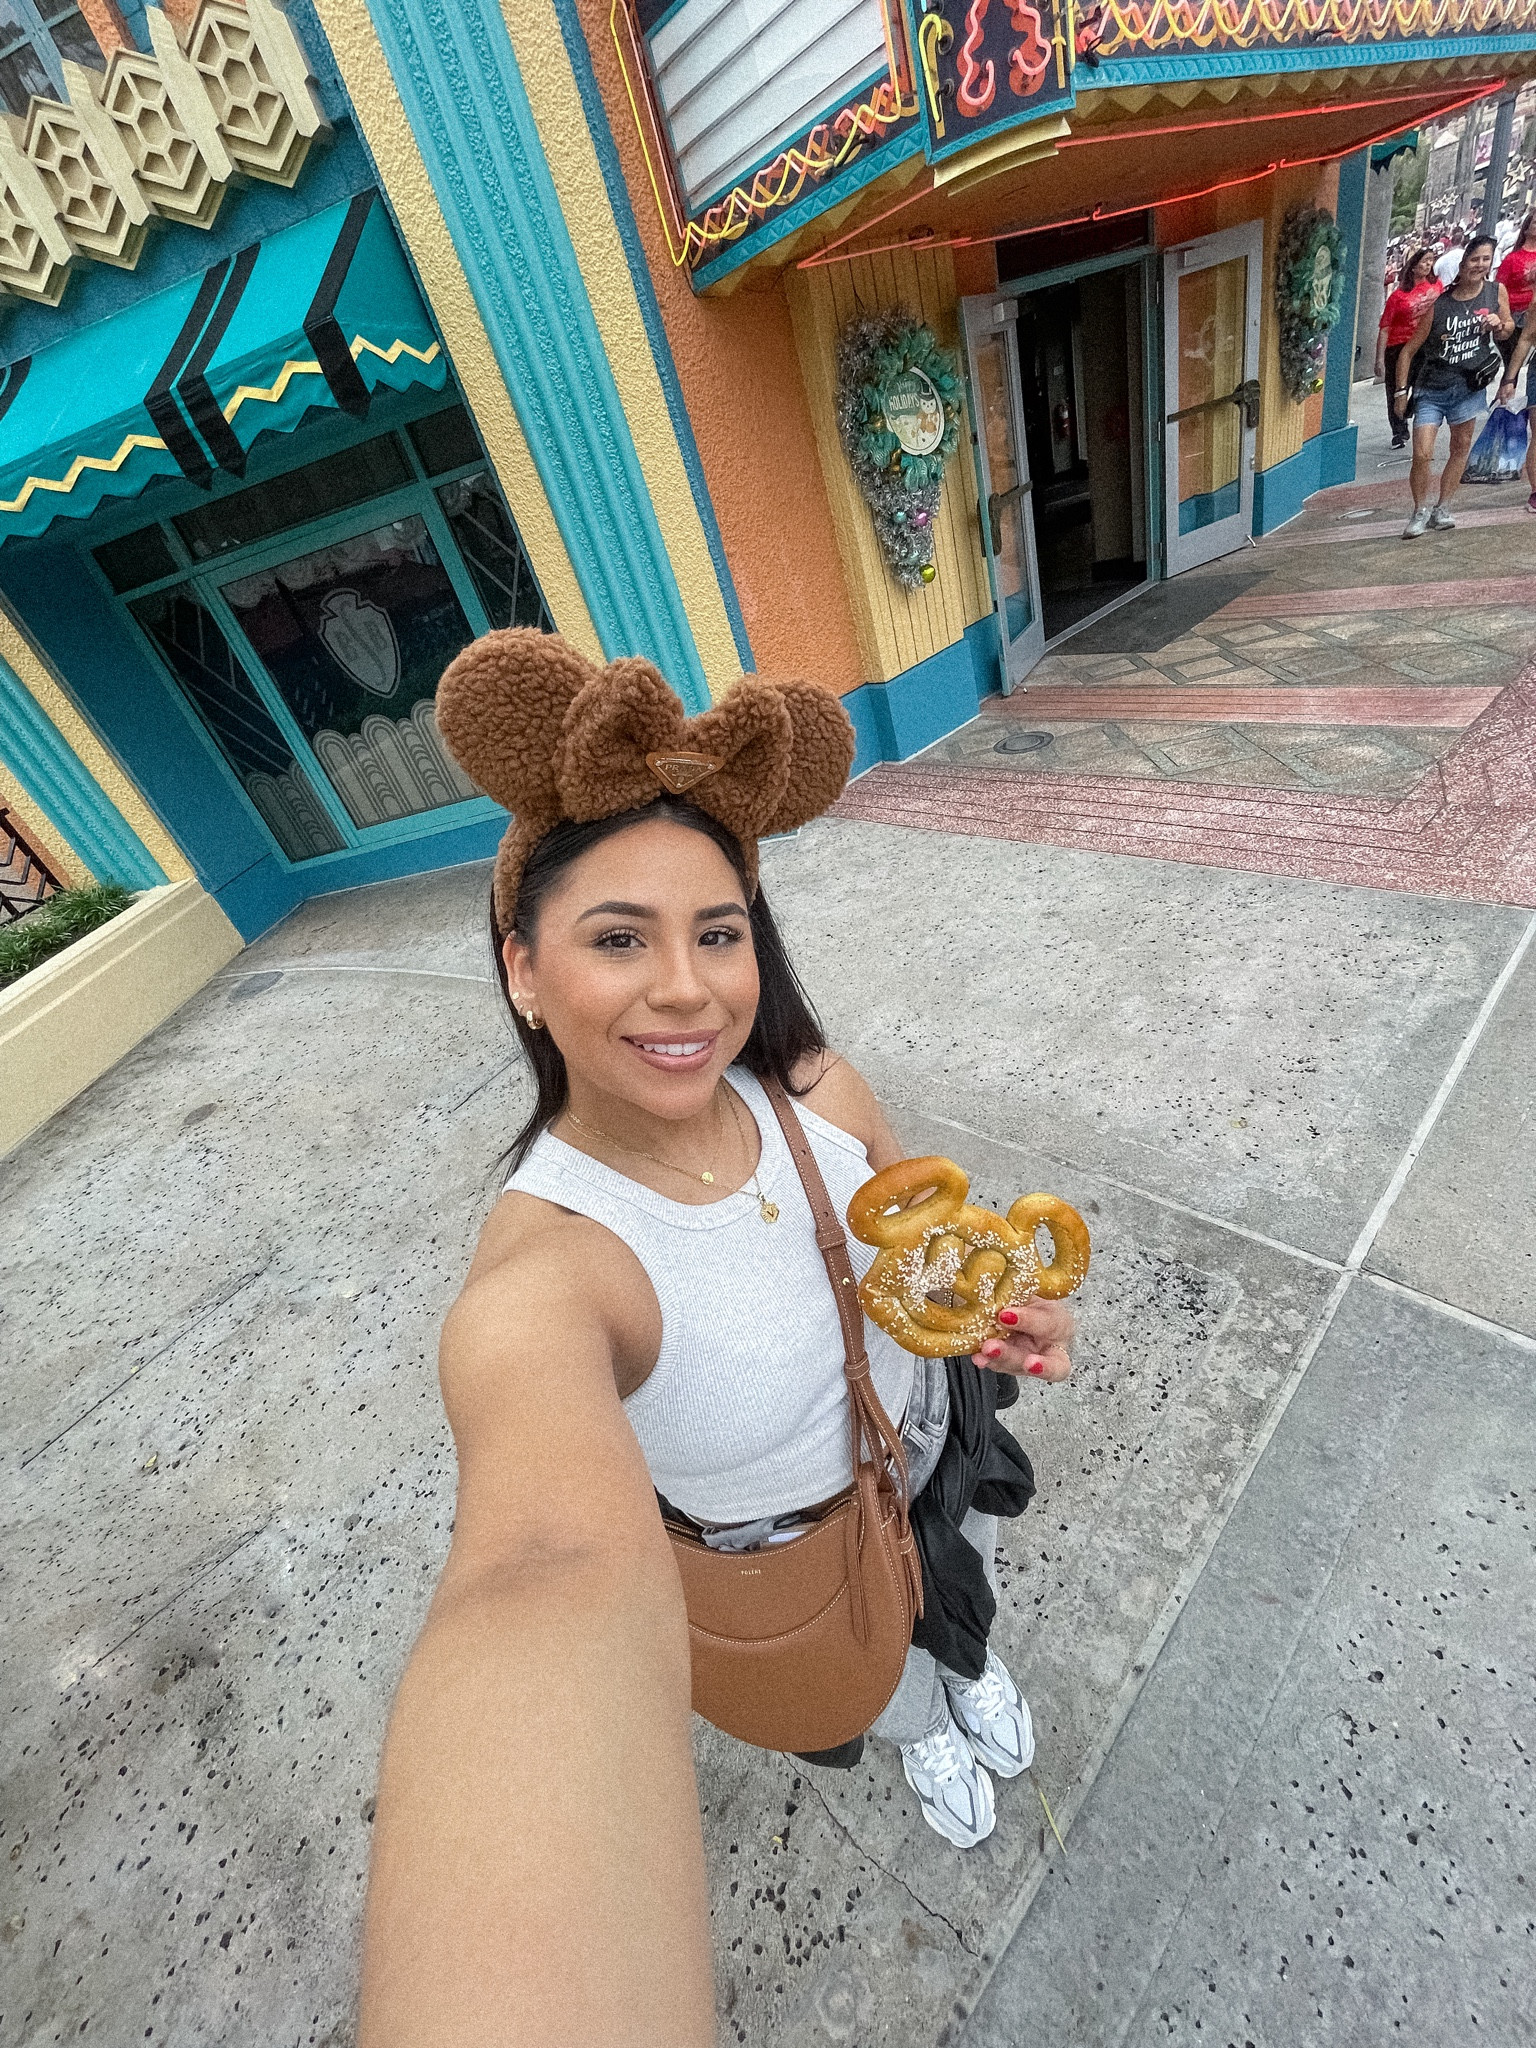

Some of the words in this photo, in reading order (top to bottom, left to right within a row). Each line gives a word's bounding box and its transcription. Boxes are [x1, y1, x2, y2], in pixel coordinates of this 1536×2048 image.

[1455, 326, 1470, 343] got
[1440, 336, 1480, 358] Friend
[1449, 355, 1459, 364] in
[888, 392, 920, 411] HOLIDAYS
